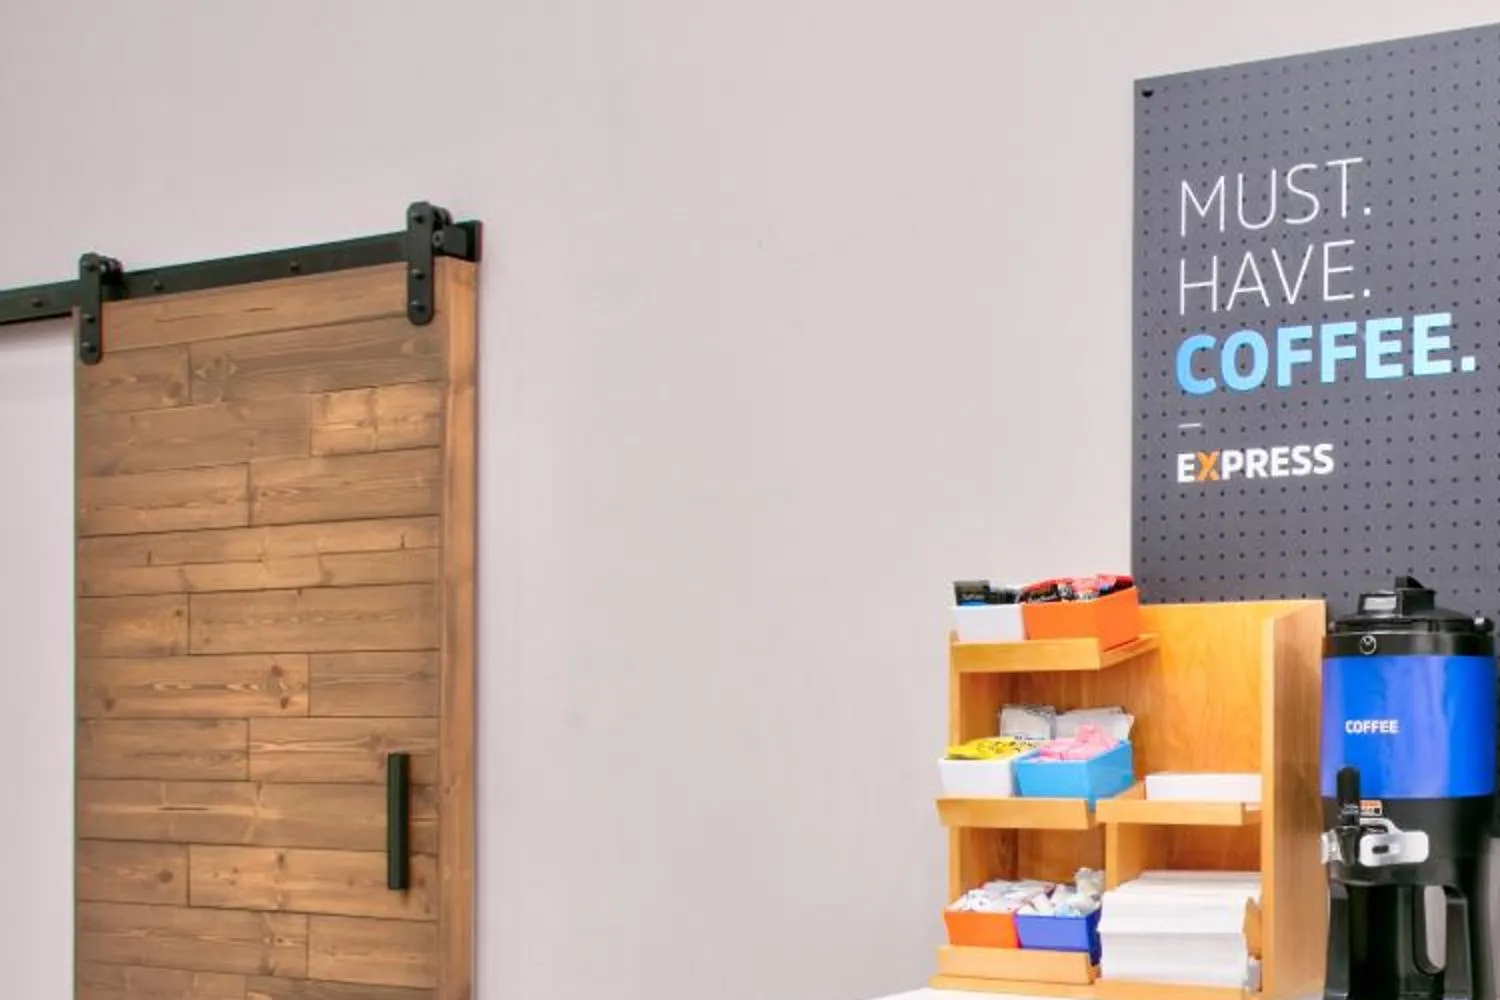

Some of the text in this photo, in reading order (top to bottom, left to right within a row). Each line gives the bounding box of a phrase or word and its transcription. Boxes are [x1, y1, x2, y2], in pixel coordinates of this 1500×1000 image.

[1180, 156, 1371, 238] MUST.
[1179, 239, 1371, 316] HAVE.
[1175, 312, 1476, 395] COFFEE.
[1177, 443, 1335, 483] EXPRESS
[1345, 719, 1400, 735] COFFEE
